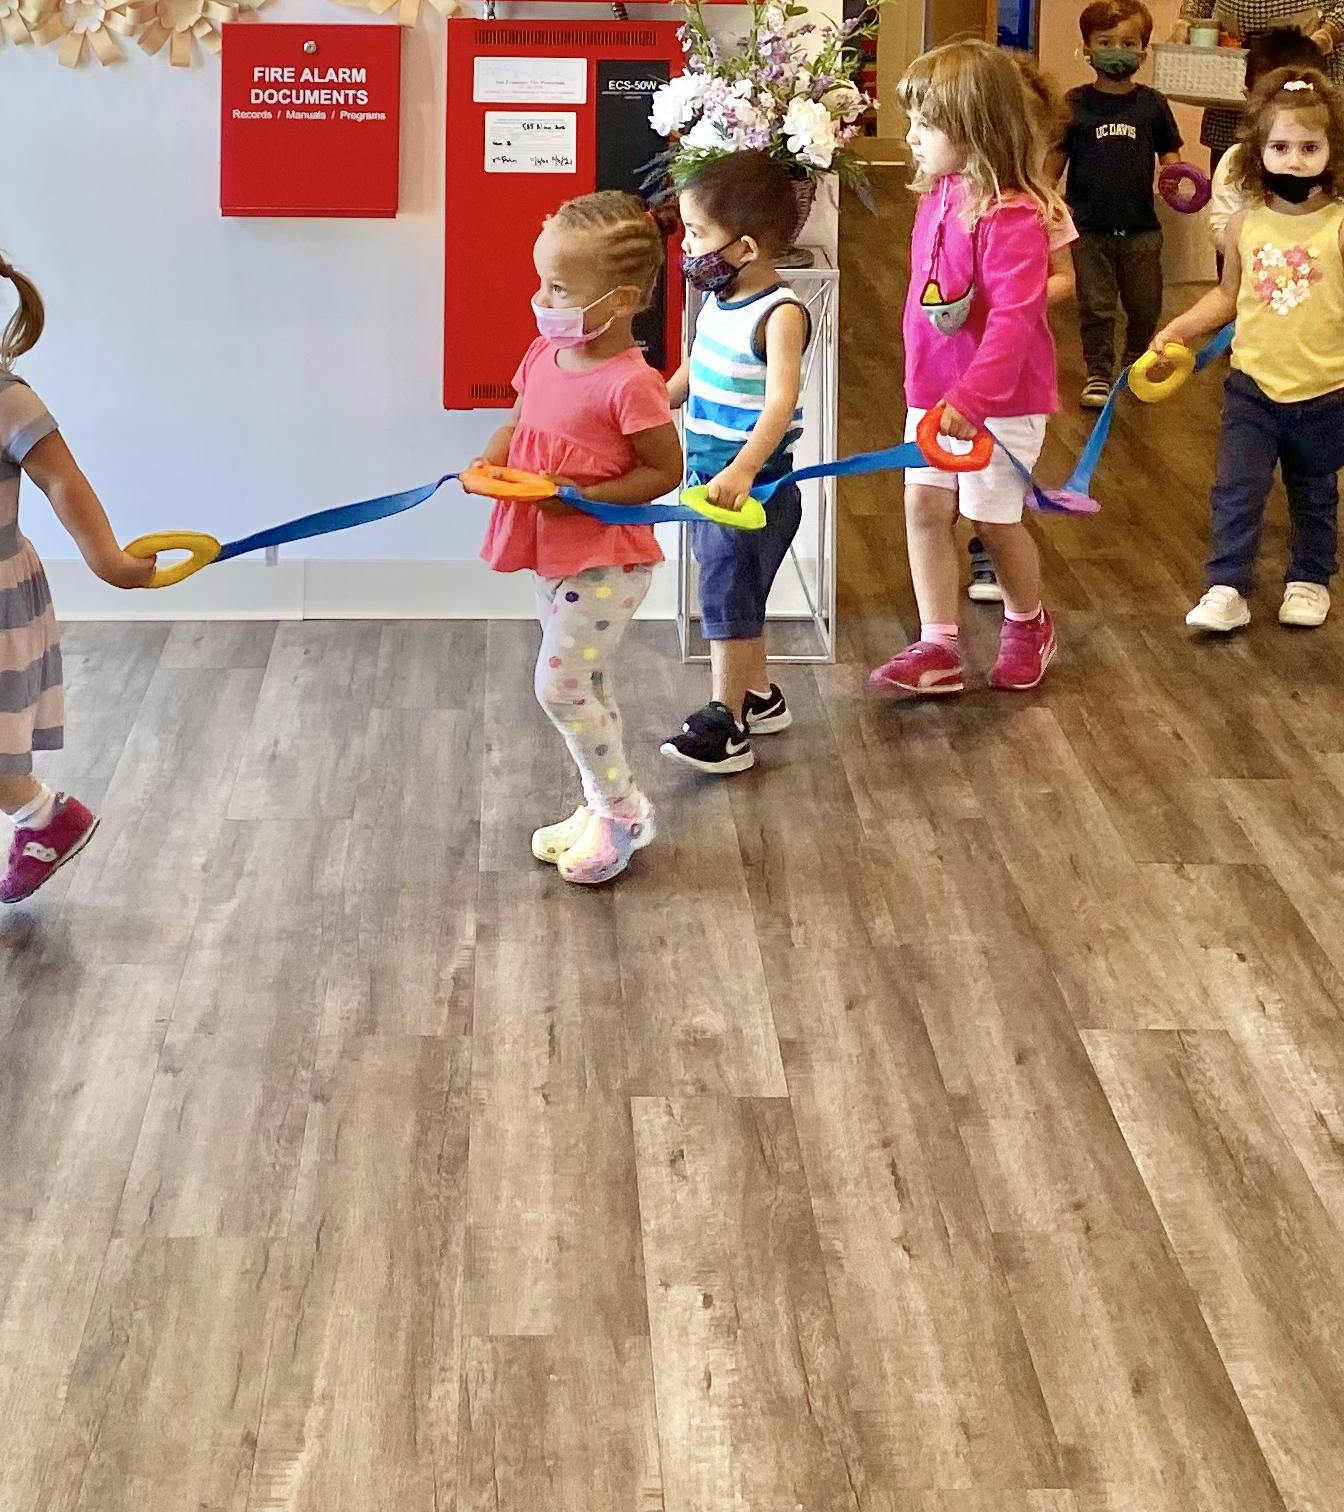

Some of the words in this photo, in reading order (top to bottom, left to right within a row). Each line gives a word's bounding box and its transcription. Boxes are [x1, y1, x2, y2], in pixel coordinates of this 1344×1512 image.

[253, 66, 296, 83] FIRE
[299, 67, 367, 84] ALARM
[608, 79, 657, 90] ECS-50W
[250, 88, 369, 105] DOCUMENTS
[232, 109, 273, 120] Records
[285, 109, 327, 121] Manuals
[339, 110, 387, 123] Programs
[1096, 124, 1109, 139] UC
[1109, 123, 1136, 139] DAVIS
